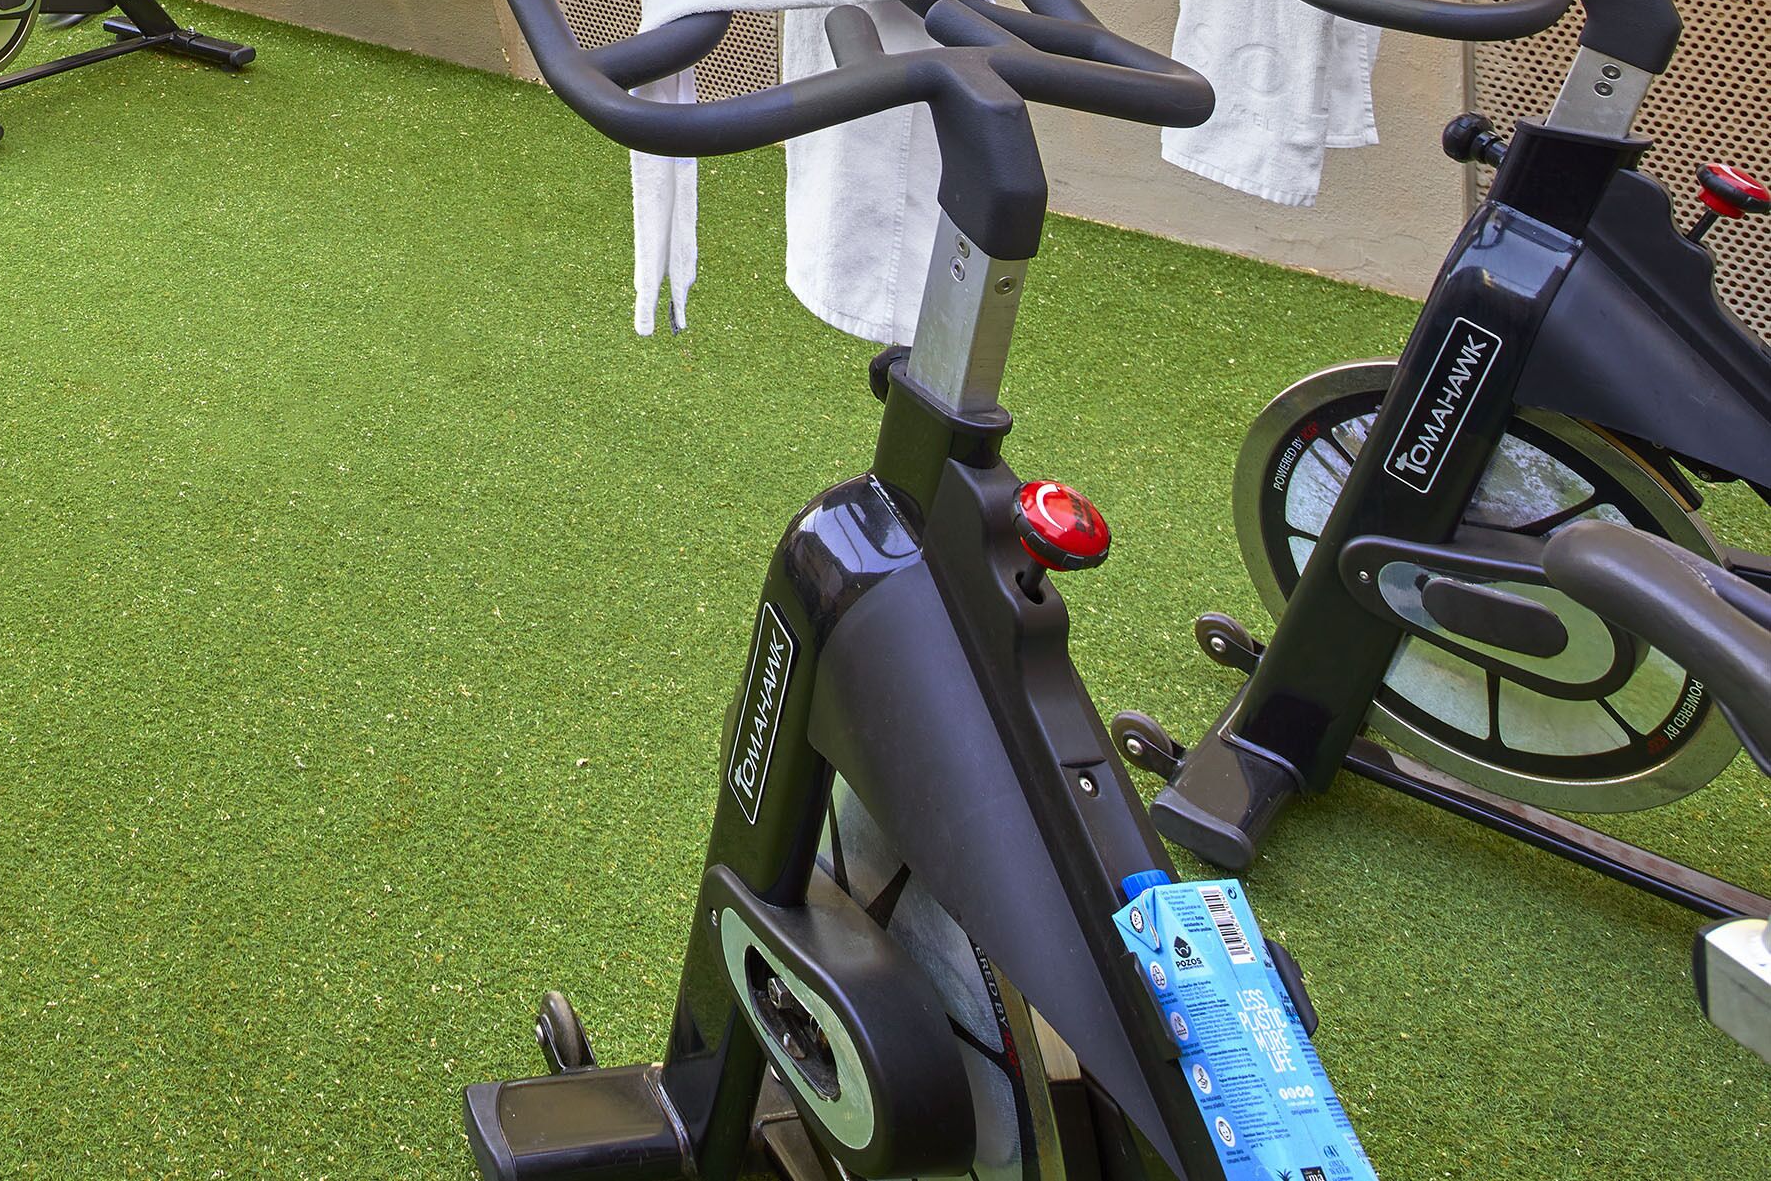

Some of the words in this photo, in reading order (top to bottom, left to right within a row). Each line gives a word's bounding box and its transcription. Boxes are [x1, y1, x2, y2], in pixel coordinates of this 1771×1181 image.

[1394, 333, 1488, 476] TOMAHAWK
[1273, 447, 1298, 492] POWERED
[1291, 435, 1305, 451] BY
[734, 627, 785, 800] TOMAHAWK
[1673, 678, 1704, 728] POWERED
[1663, 725, 1681, 740] BY
[1175, 957, 1203, 969] POZOS
[1236, 988, 1269, 1011] LESS
[994, 1002, 1010, 1029] BY
[1237, 1007, 1289, 1033] PLASTIC
[1252, 1028, 1293, 1053] MORE
[1266, 1049, 1297, 1074] LIFE
